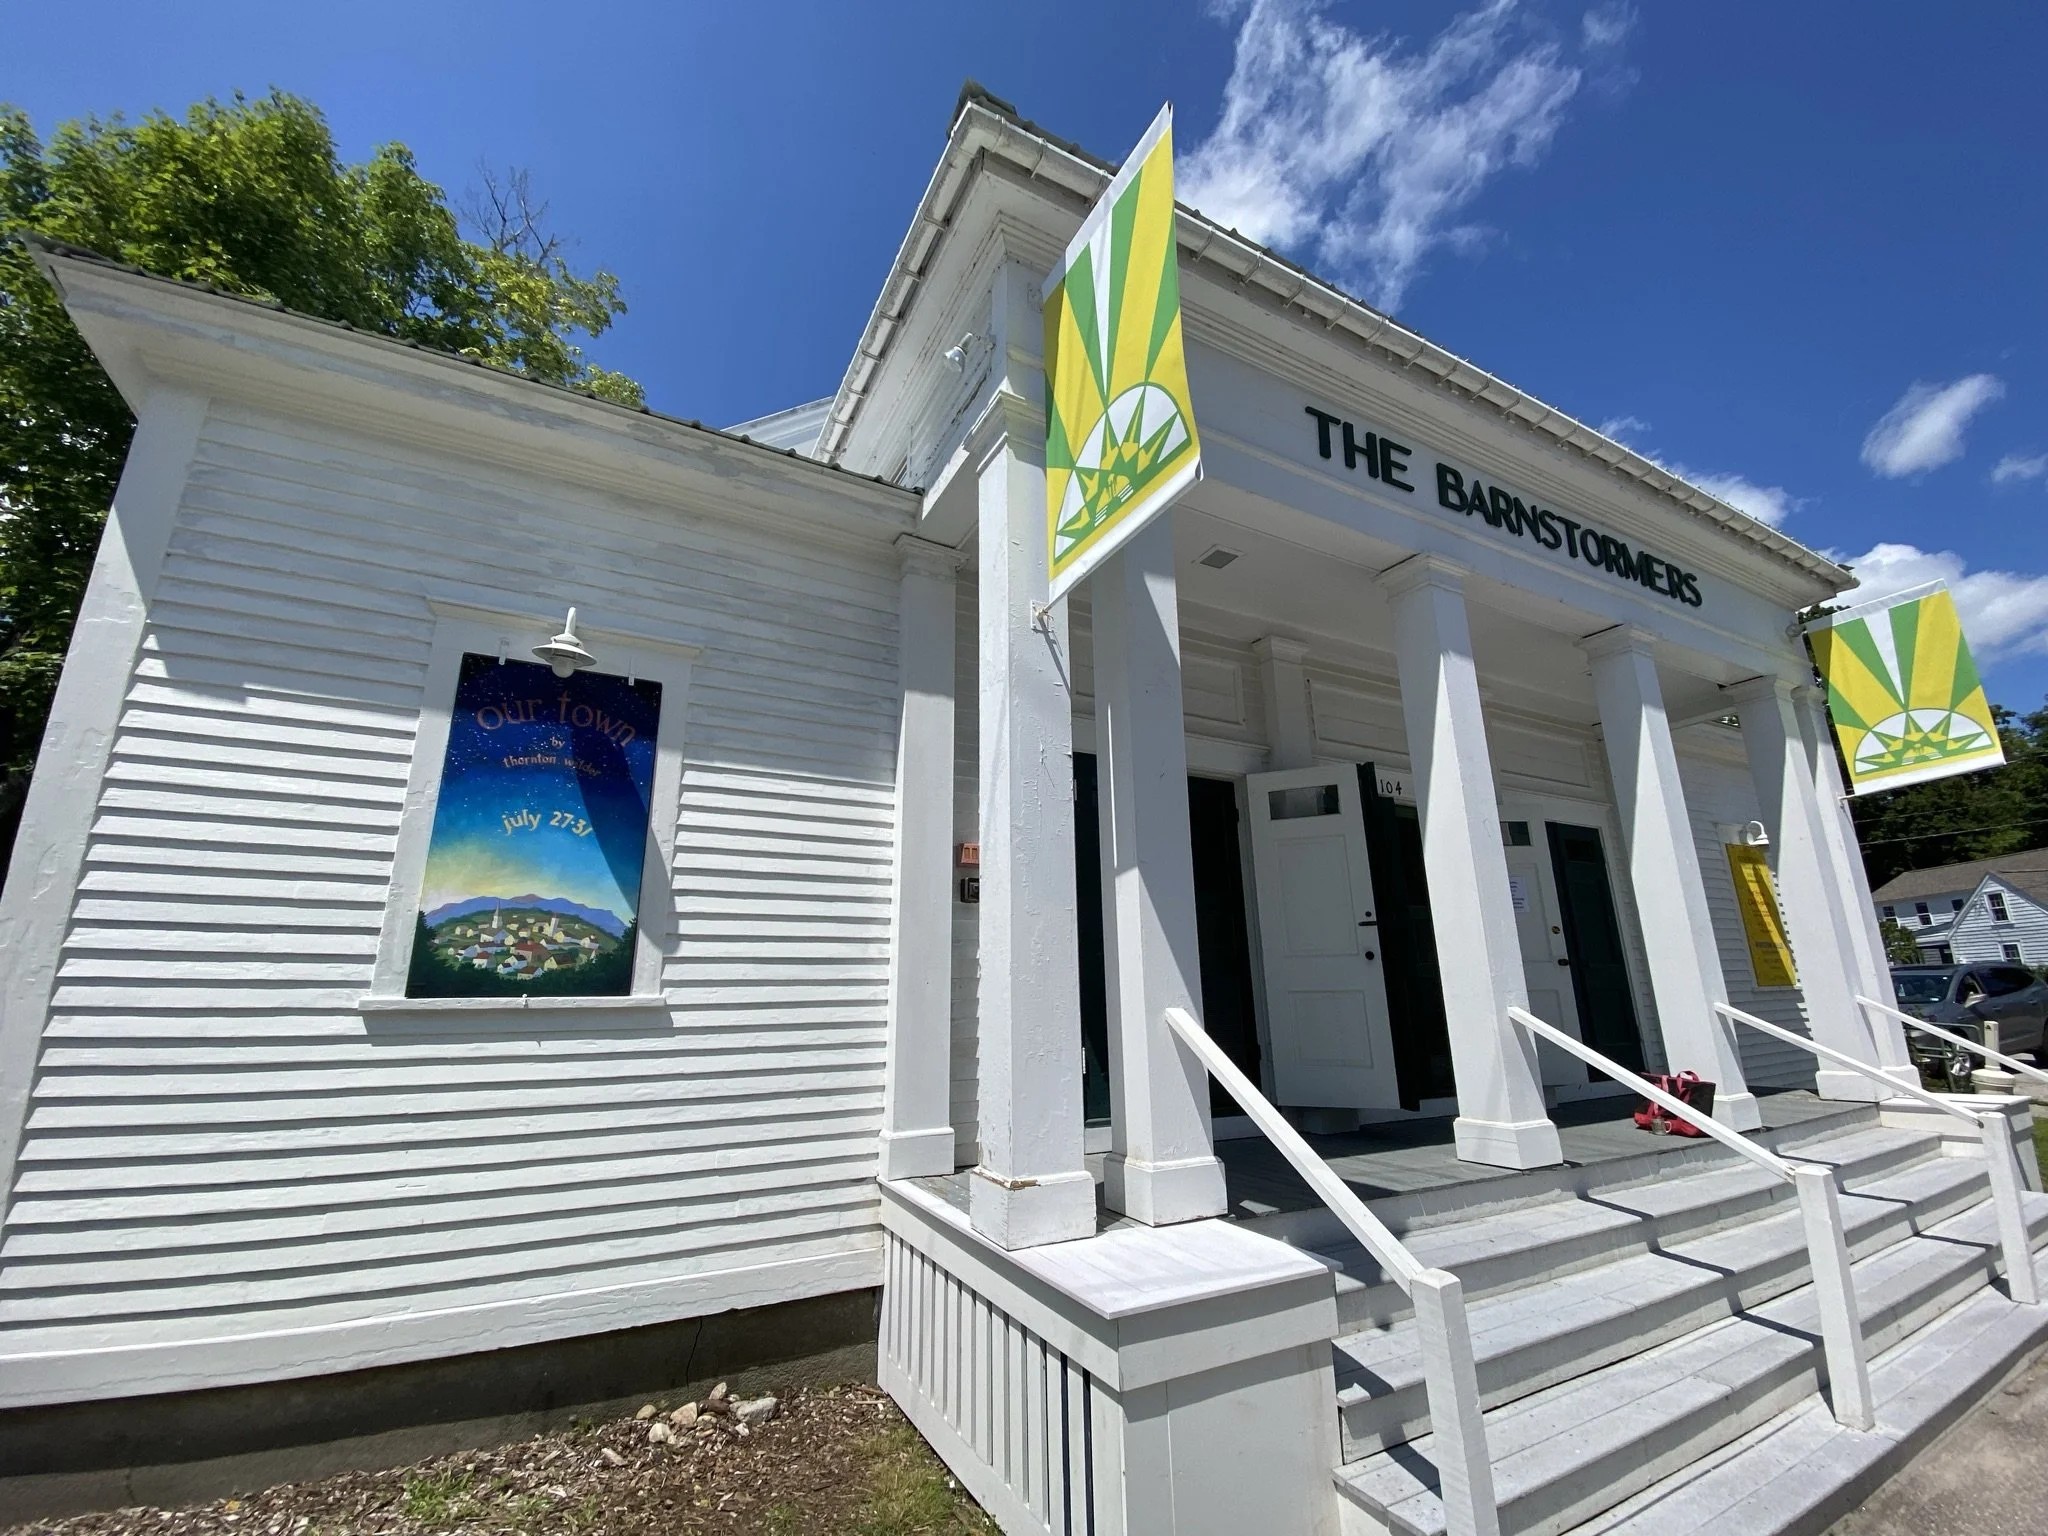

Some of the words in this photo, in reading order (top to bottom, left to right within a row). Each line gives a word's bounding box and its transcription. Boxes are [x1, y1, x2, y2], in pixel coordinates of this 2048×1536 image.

[1306, 406, 1415, 492] THE
[1436, 462, 1702, 607] BARNSTORMERS
[557, 690, 635, 747] town
[550, 736, 565, 749] by
[503, 753, 556, 768] thornton
[1380, 779, 1402, 796] 104
[502, 808, 541, 836] july
